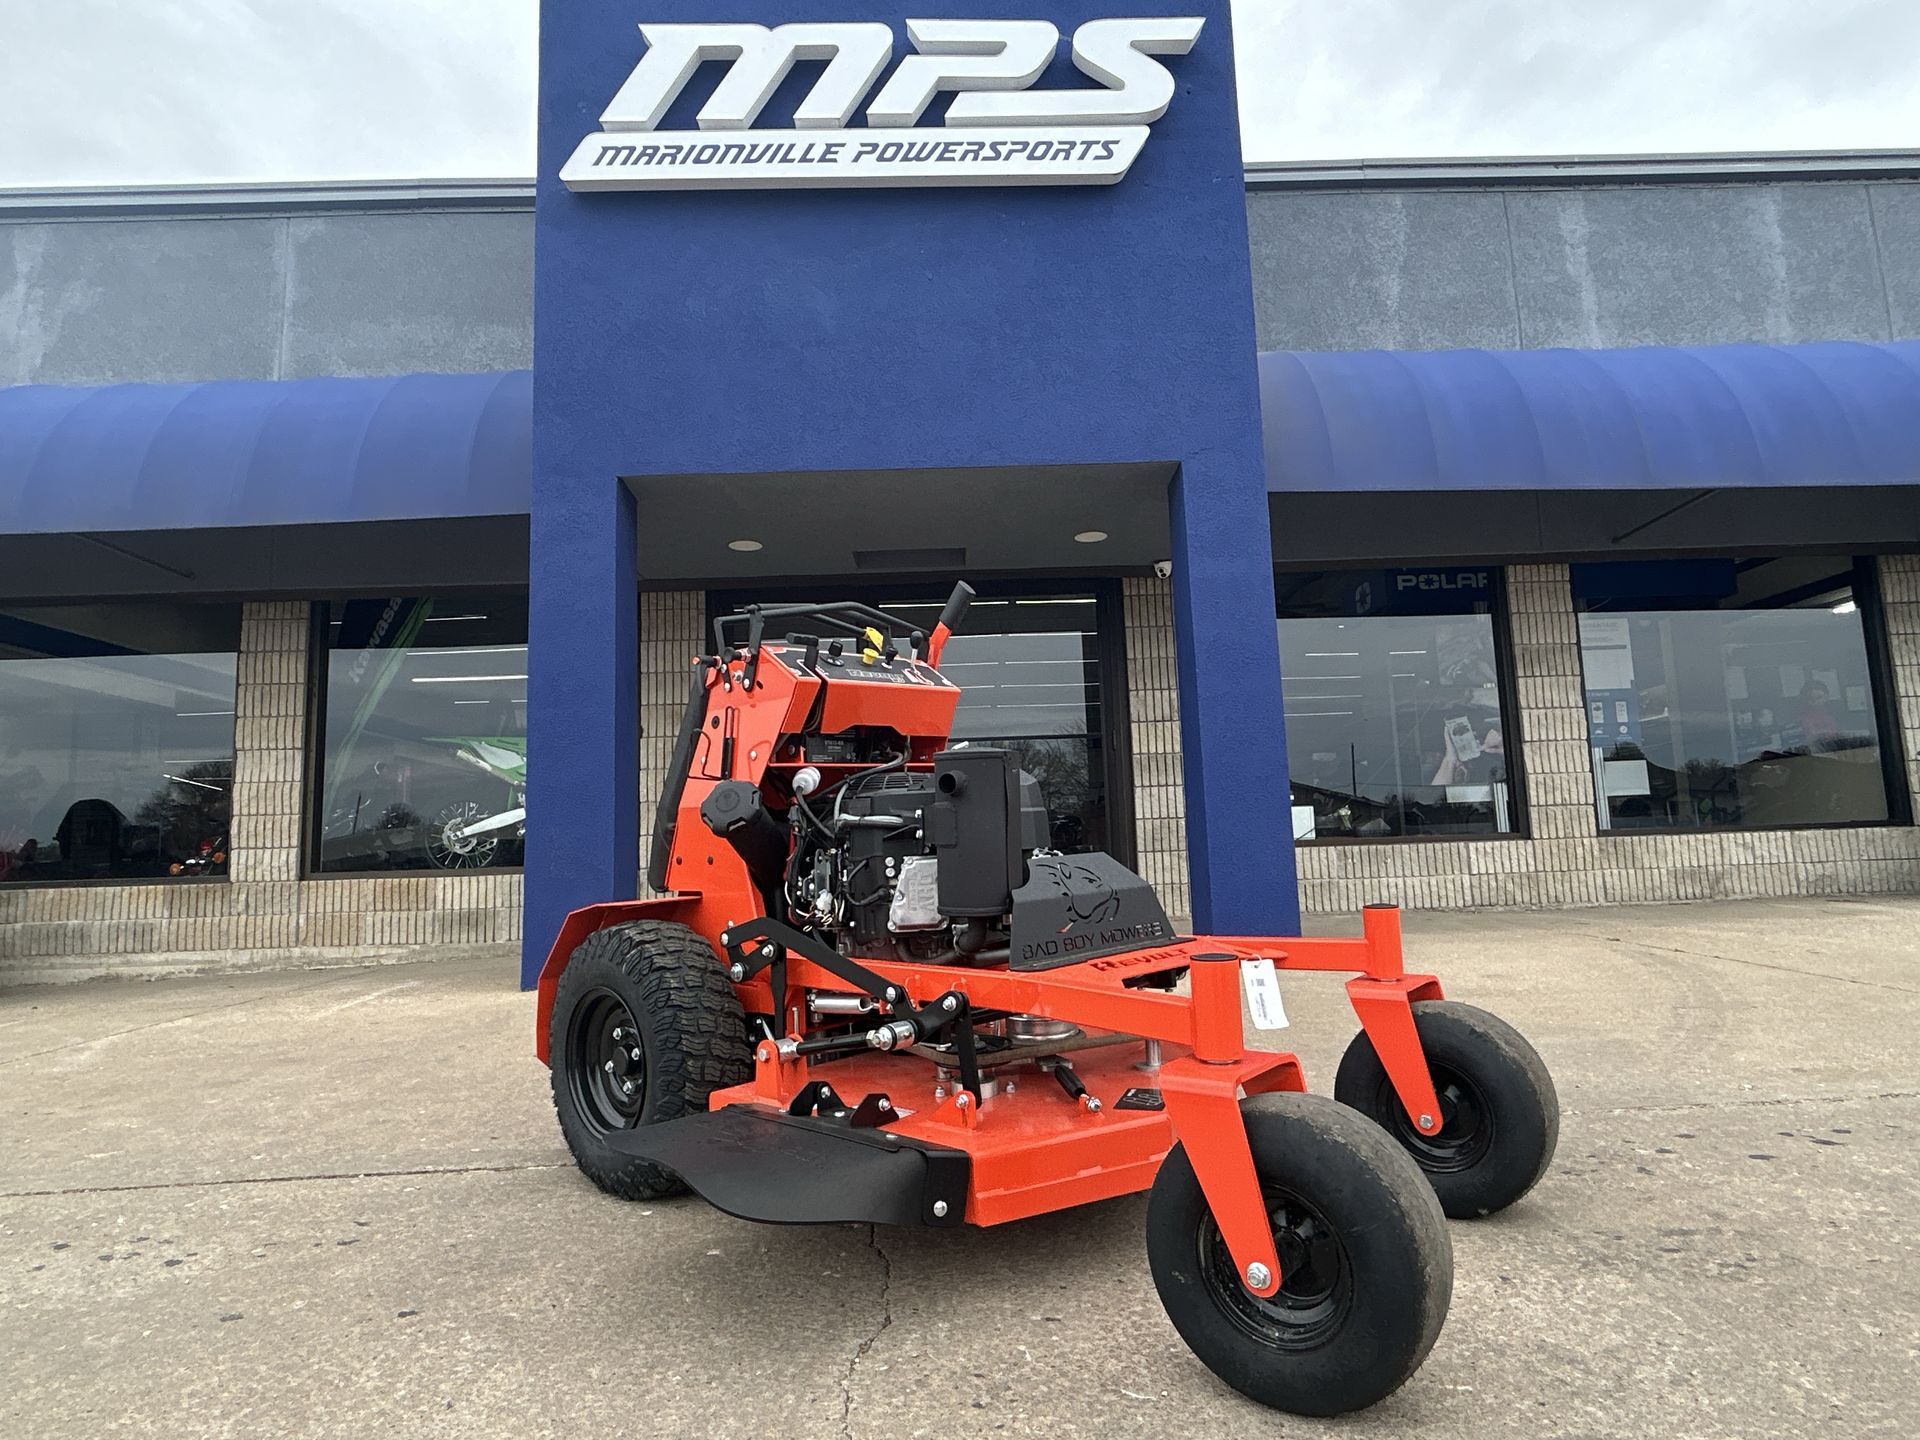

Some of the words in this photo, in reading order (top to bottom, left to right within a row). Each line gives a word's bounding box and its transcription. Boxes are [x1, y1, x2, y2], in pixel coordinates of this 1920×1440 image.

[599, 17, 1206, 130] MPS
[592, 141, 846, 167] MARIONVILLE
[851, 138, 1121, 164] POWERSPORTS
[1022, 940, 1058, 960] BAD
[1063, 932, 1097, 952] BOY
[1100, 921, 1164, 946] MOWERS
